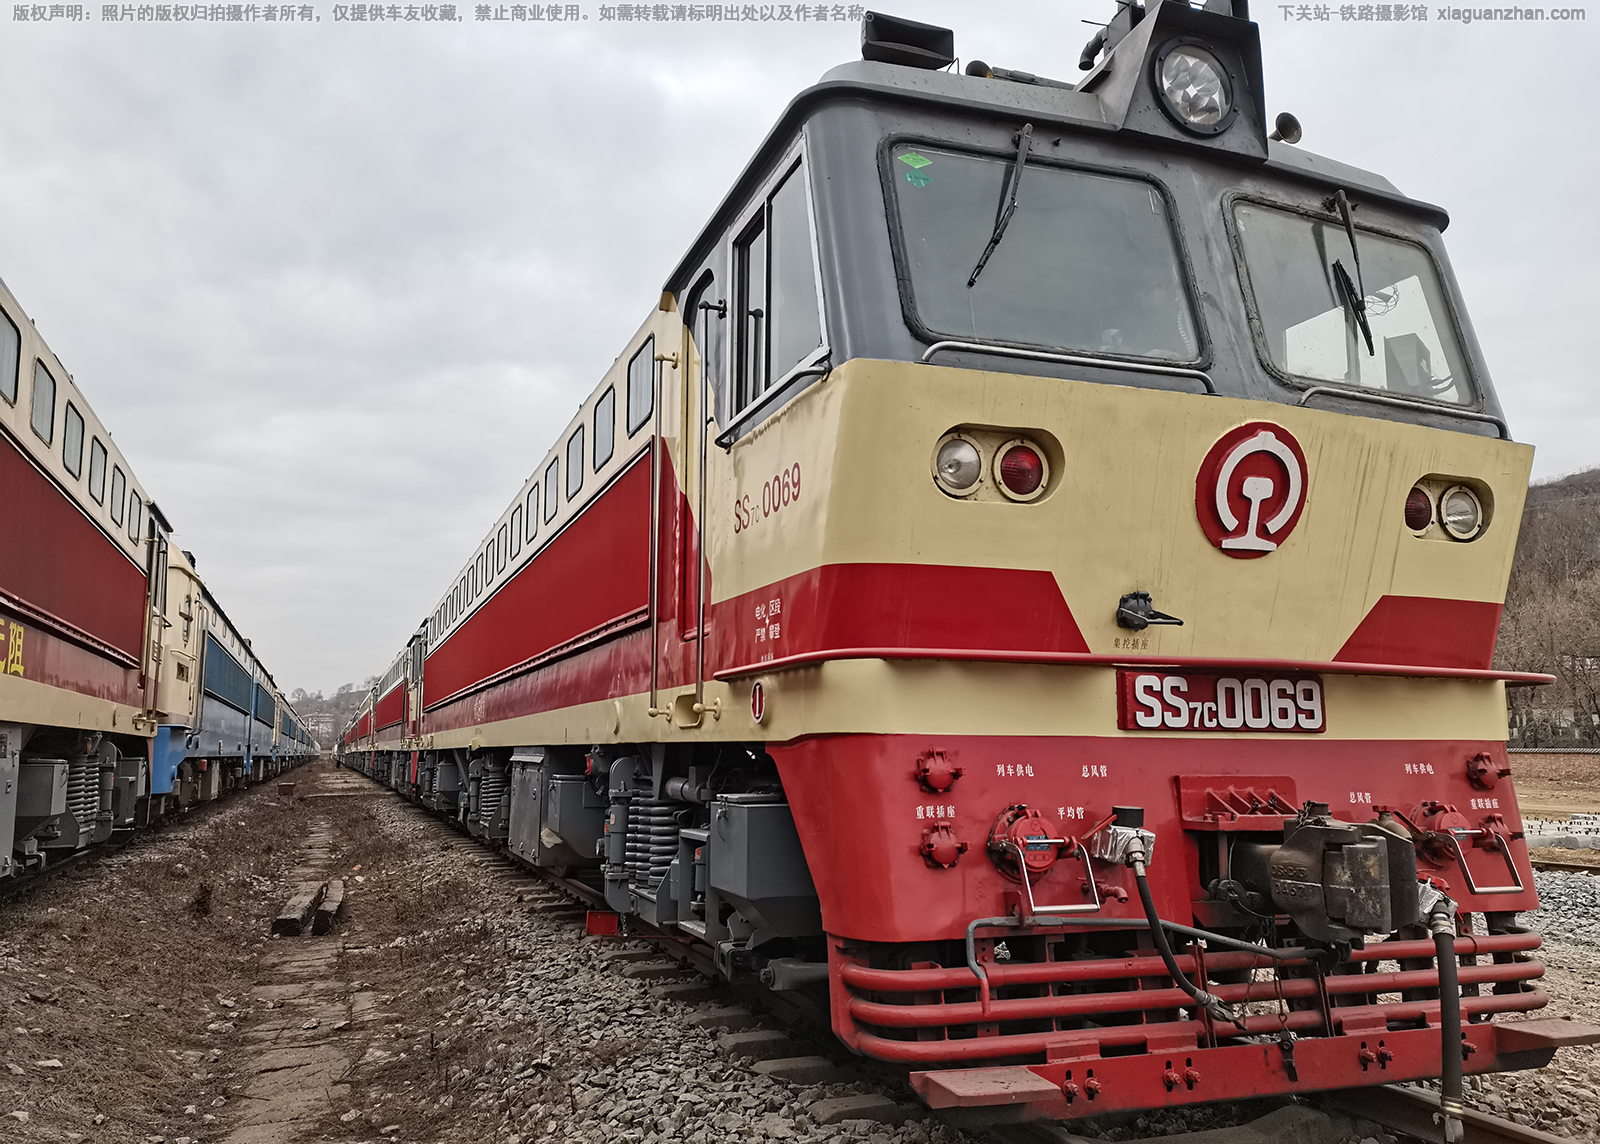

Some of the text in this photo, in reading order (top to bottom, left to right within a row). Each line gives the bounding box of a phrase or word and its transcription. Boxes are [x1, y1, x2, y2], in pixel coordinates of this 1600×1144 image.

[996, 764, 1035, 777] 列车供电
[1082, 764, 1109, 778] 总风管
[1404, 763, 1434, 775] 列车供电
[1349, 791, 1372, 804] 总风管
[1470, 798, 1500, 810] 重联插座
[915, 804, 956, 820] 重联插座
[1057, 806, 1085, 820] 平均管
